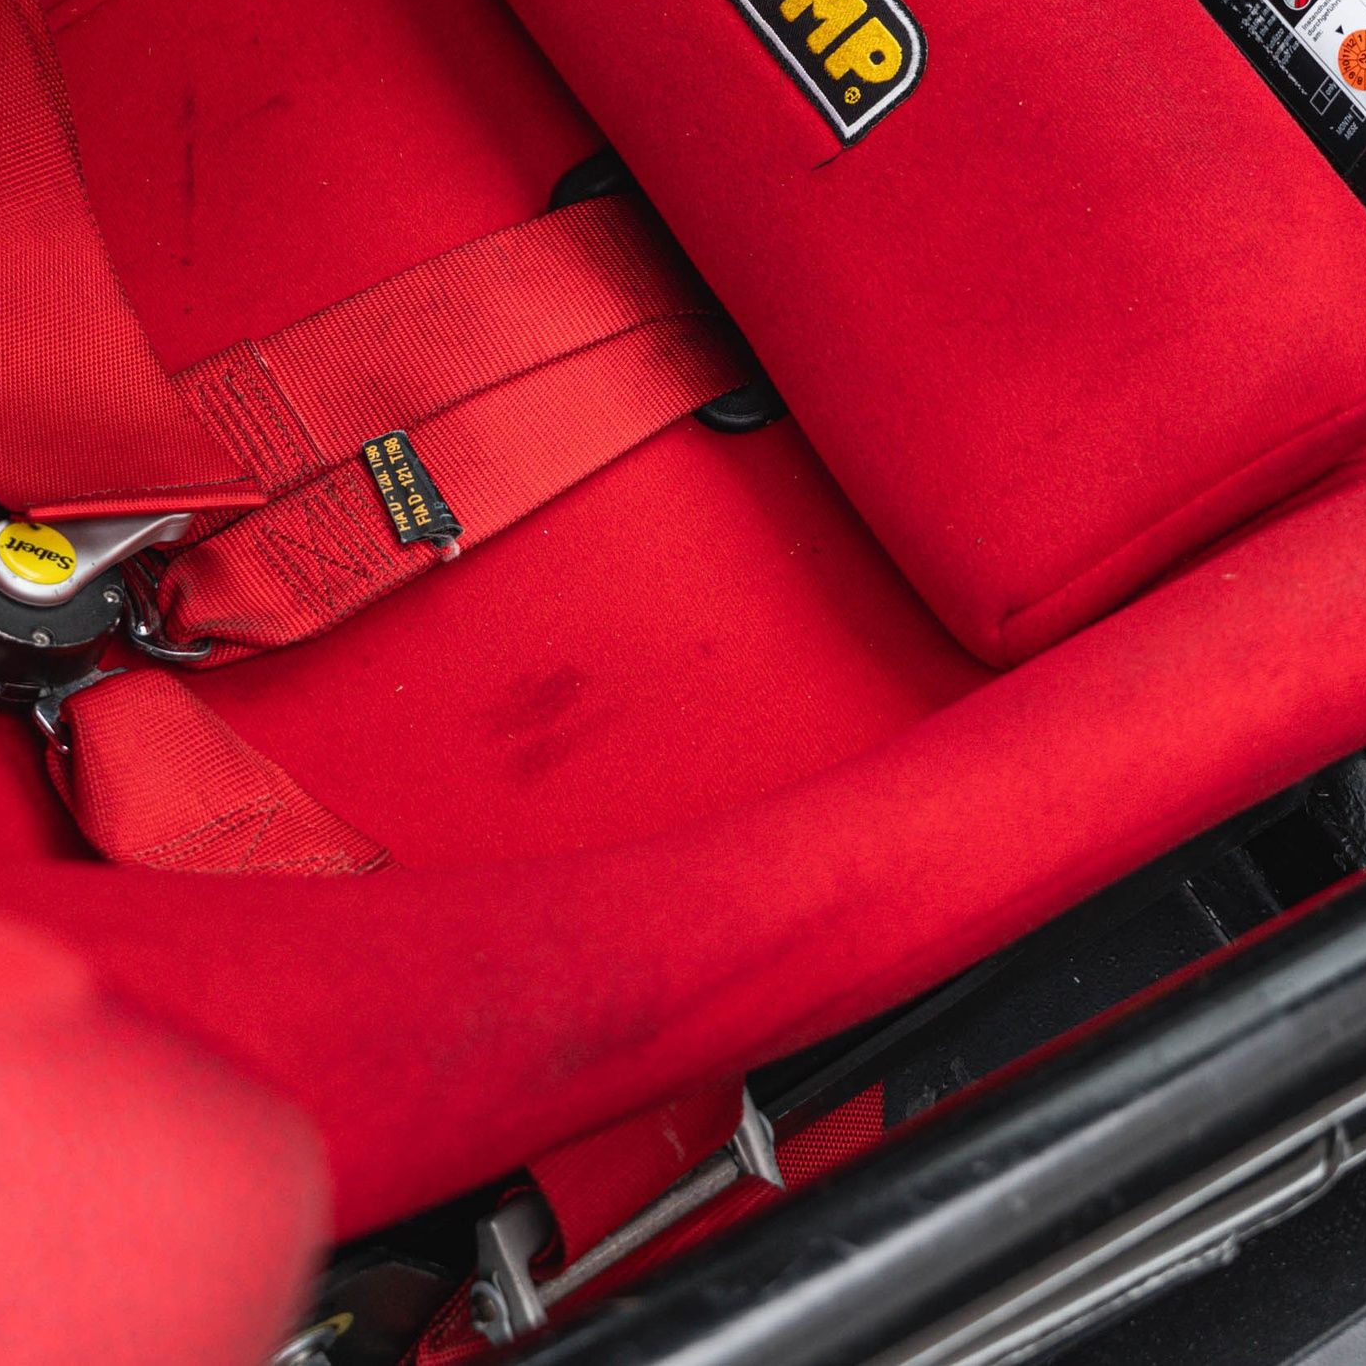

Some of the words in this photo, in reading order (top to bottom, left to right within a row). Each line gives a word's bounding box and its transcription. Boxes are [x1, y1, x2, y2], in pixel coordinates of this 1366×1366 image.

[1357, 34, 1362, 42] 1
[1357, 77, 1363, 85] 8
[384, 437, 404, 463] T/98
[396, 462, 414, 486] 121.
[408, 494, 422, 504] D
[395, 512, 410, 531] FIA
[414, 504, 431, 525] FIA
[3, 536, 74, 571] Sabelt
